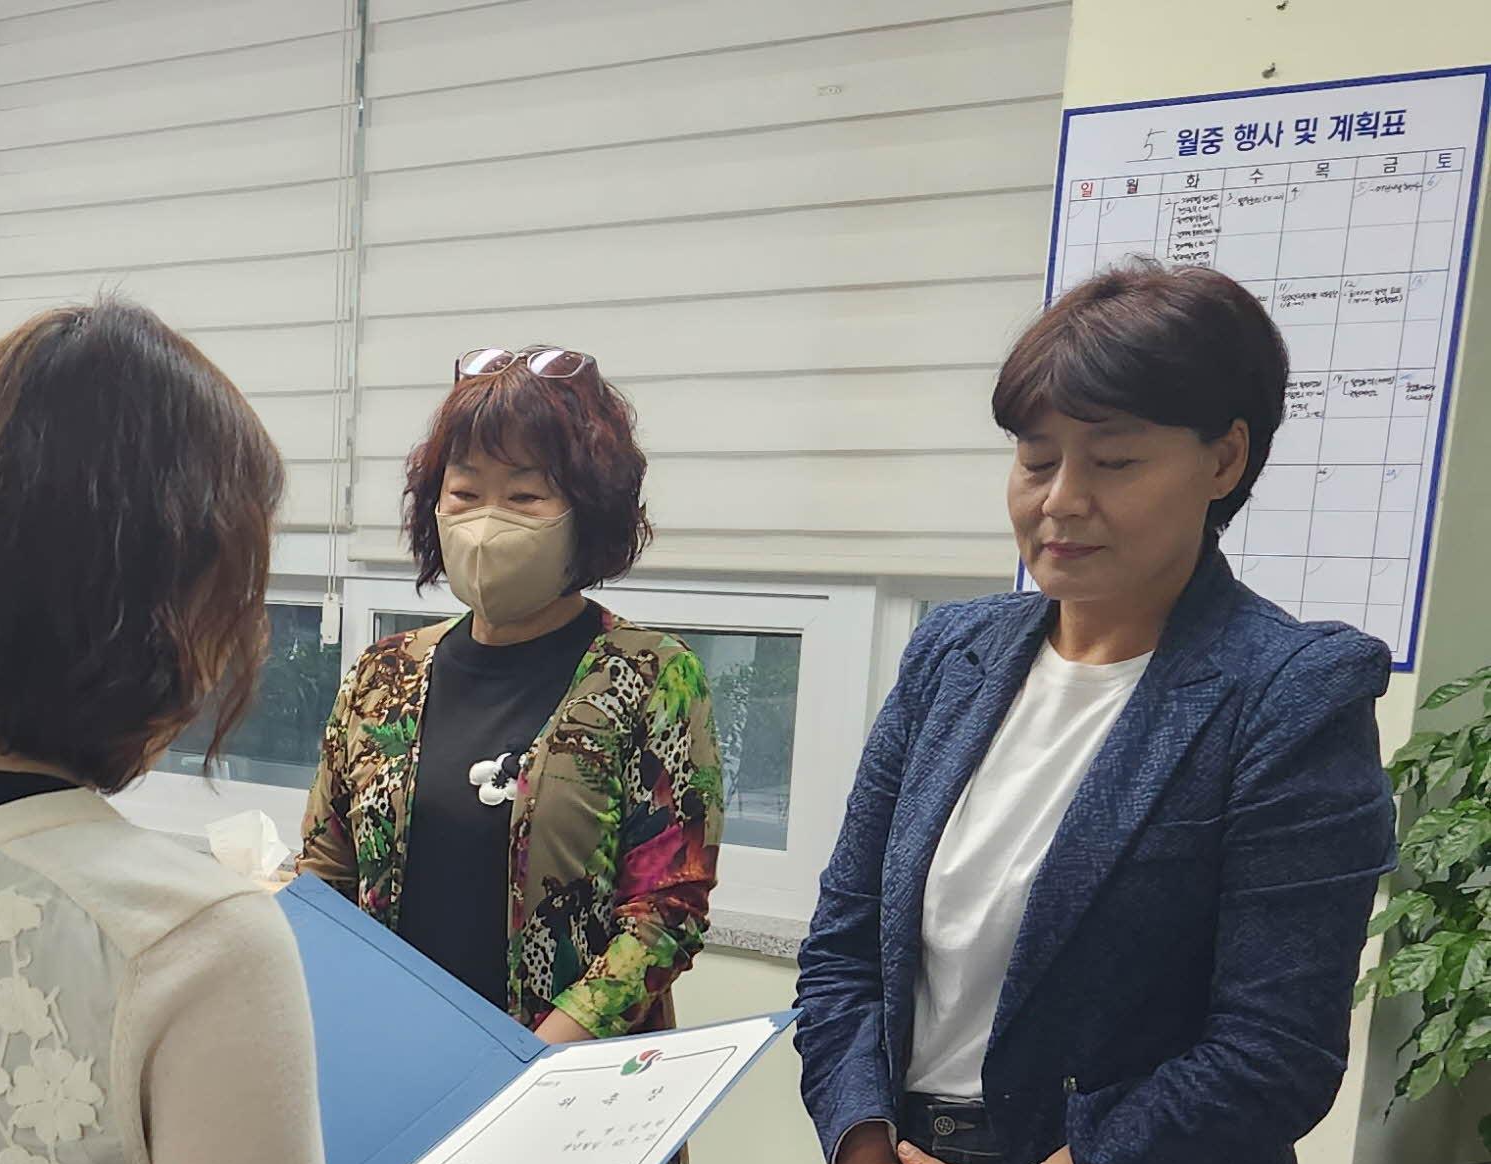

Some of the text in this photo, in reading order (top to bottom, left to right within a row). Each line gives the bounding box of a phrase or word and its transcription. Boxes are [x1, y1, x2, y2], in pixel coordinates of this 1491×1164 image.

[1176, 127, 1224, 156] 월중
[1234, 121, 1283, 152] 행사
[1294, 117, 1319, 145] 및
[1328, 109, 1407, 142] 계획표
[1080, 153, 1452, 198] 일 월 화 수 목 금 토
